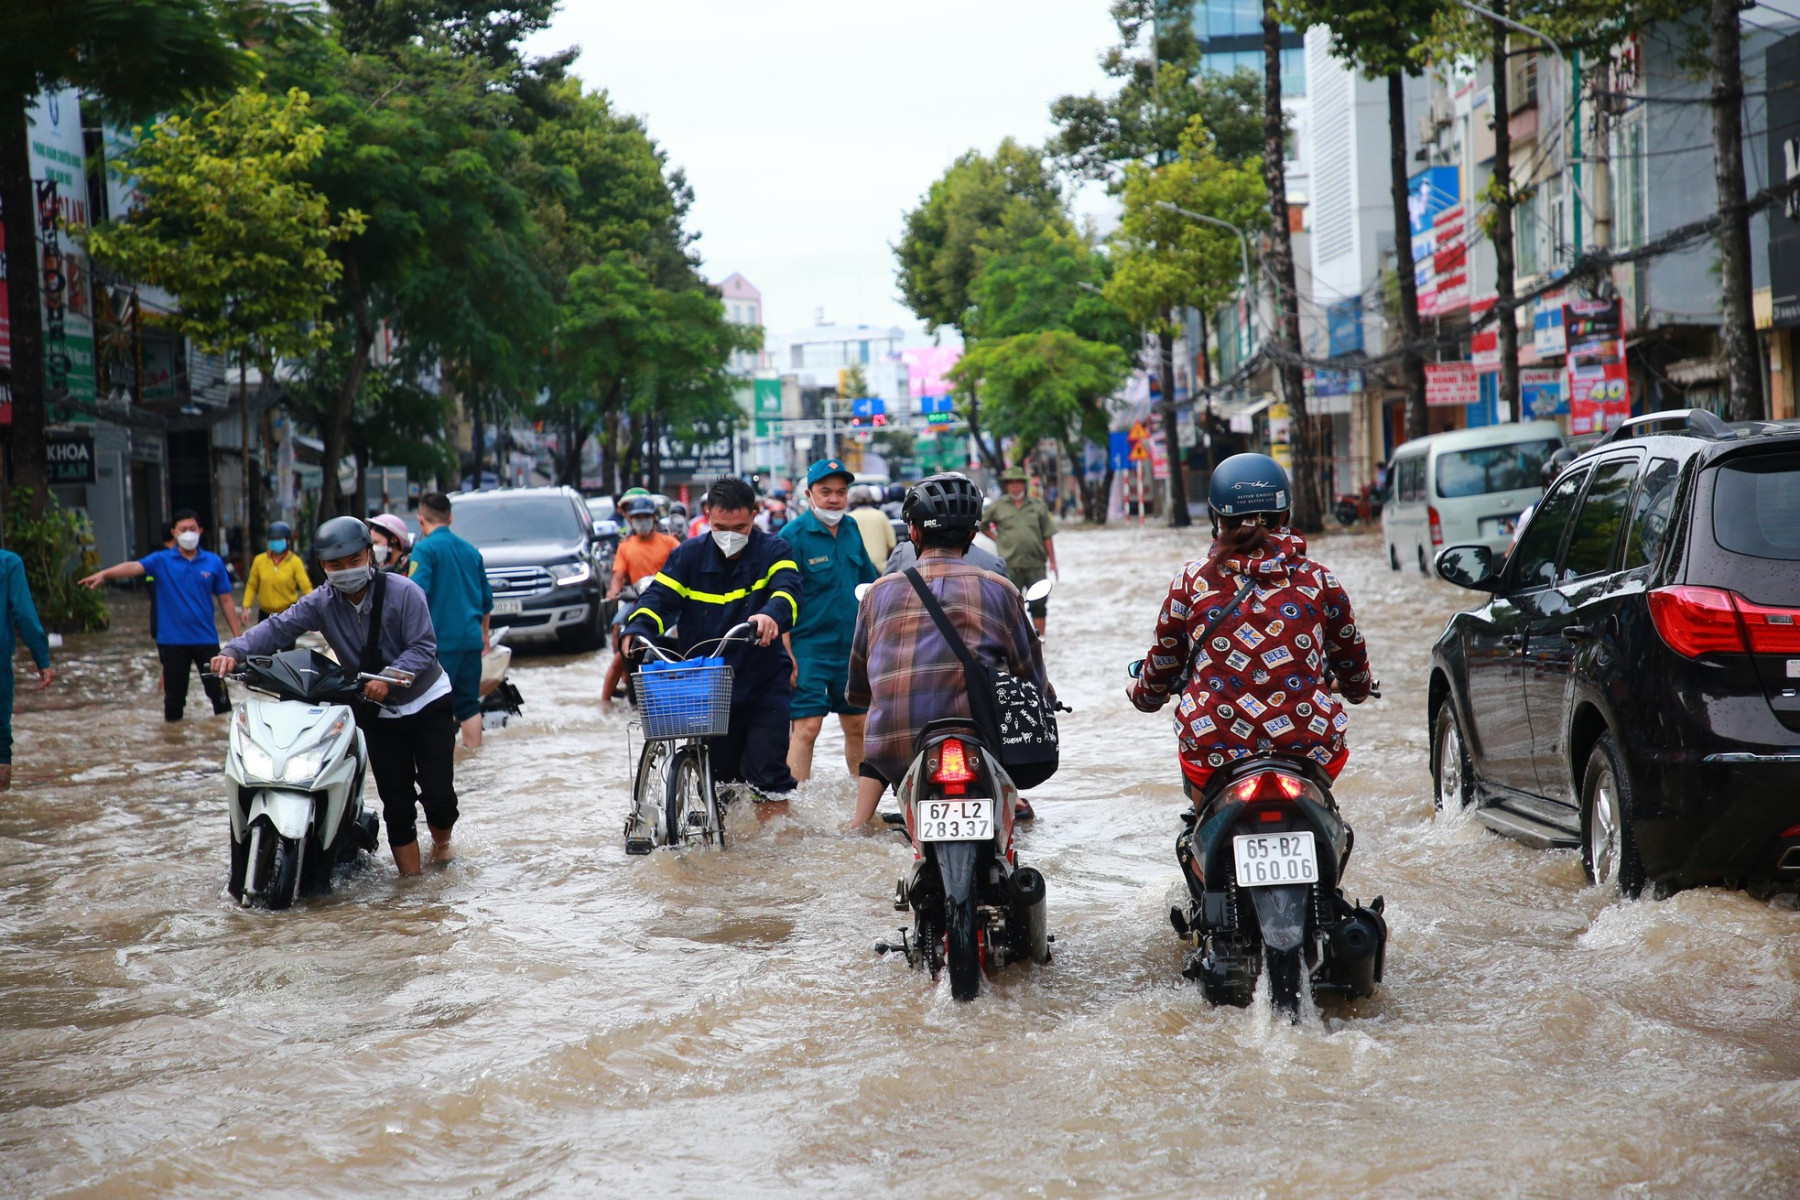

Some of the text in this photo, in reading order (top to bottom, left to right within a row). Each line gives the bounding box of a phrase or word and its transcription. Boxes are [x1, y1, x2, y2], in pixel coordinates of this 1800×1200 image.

[1589, 378, 1626, 403] 40
[46, 443, 89, 461] KHOA
[930, 802, 982, 820] 67-L2
[923, 820, 989, 838] 283.37
[1246, 836, 1302, 859] 65-B2
[1243, 858, 1313, 882] 160.06
